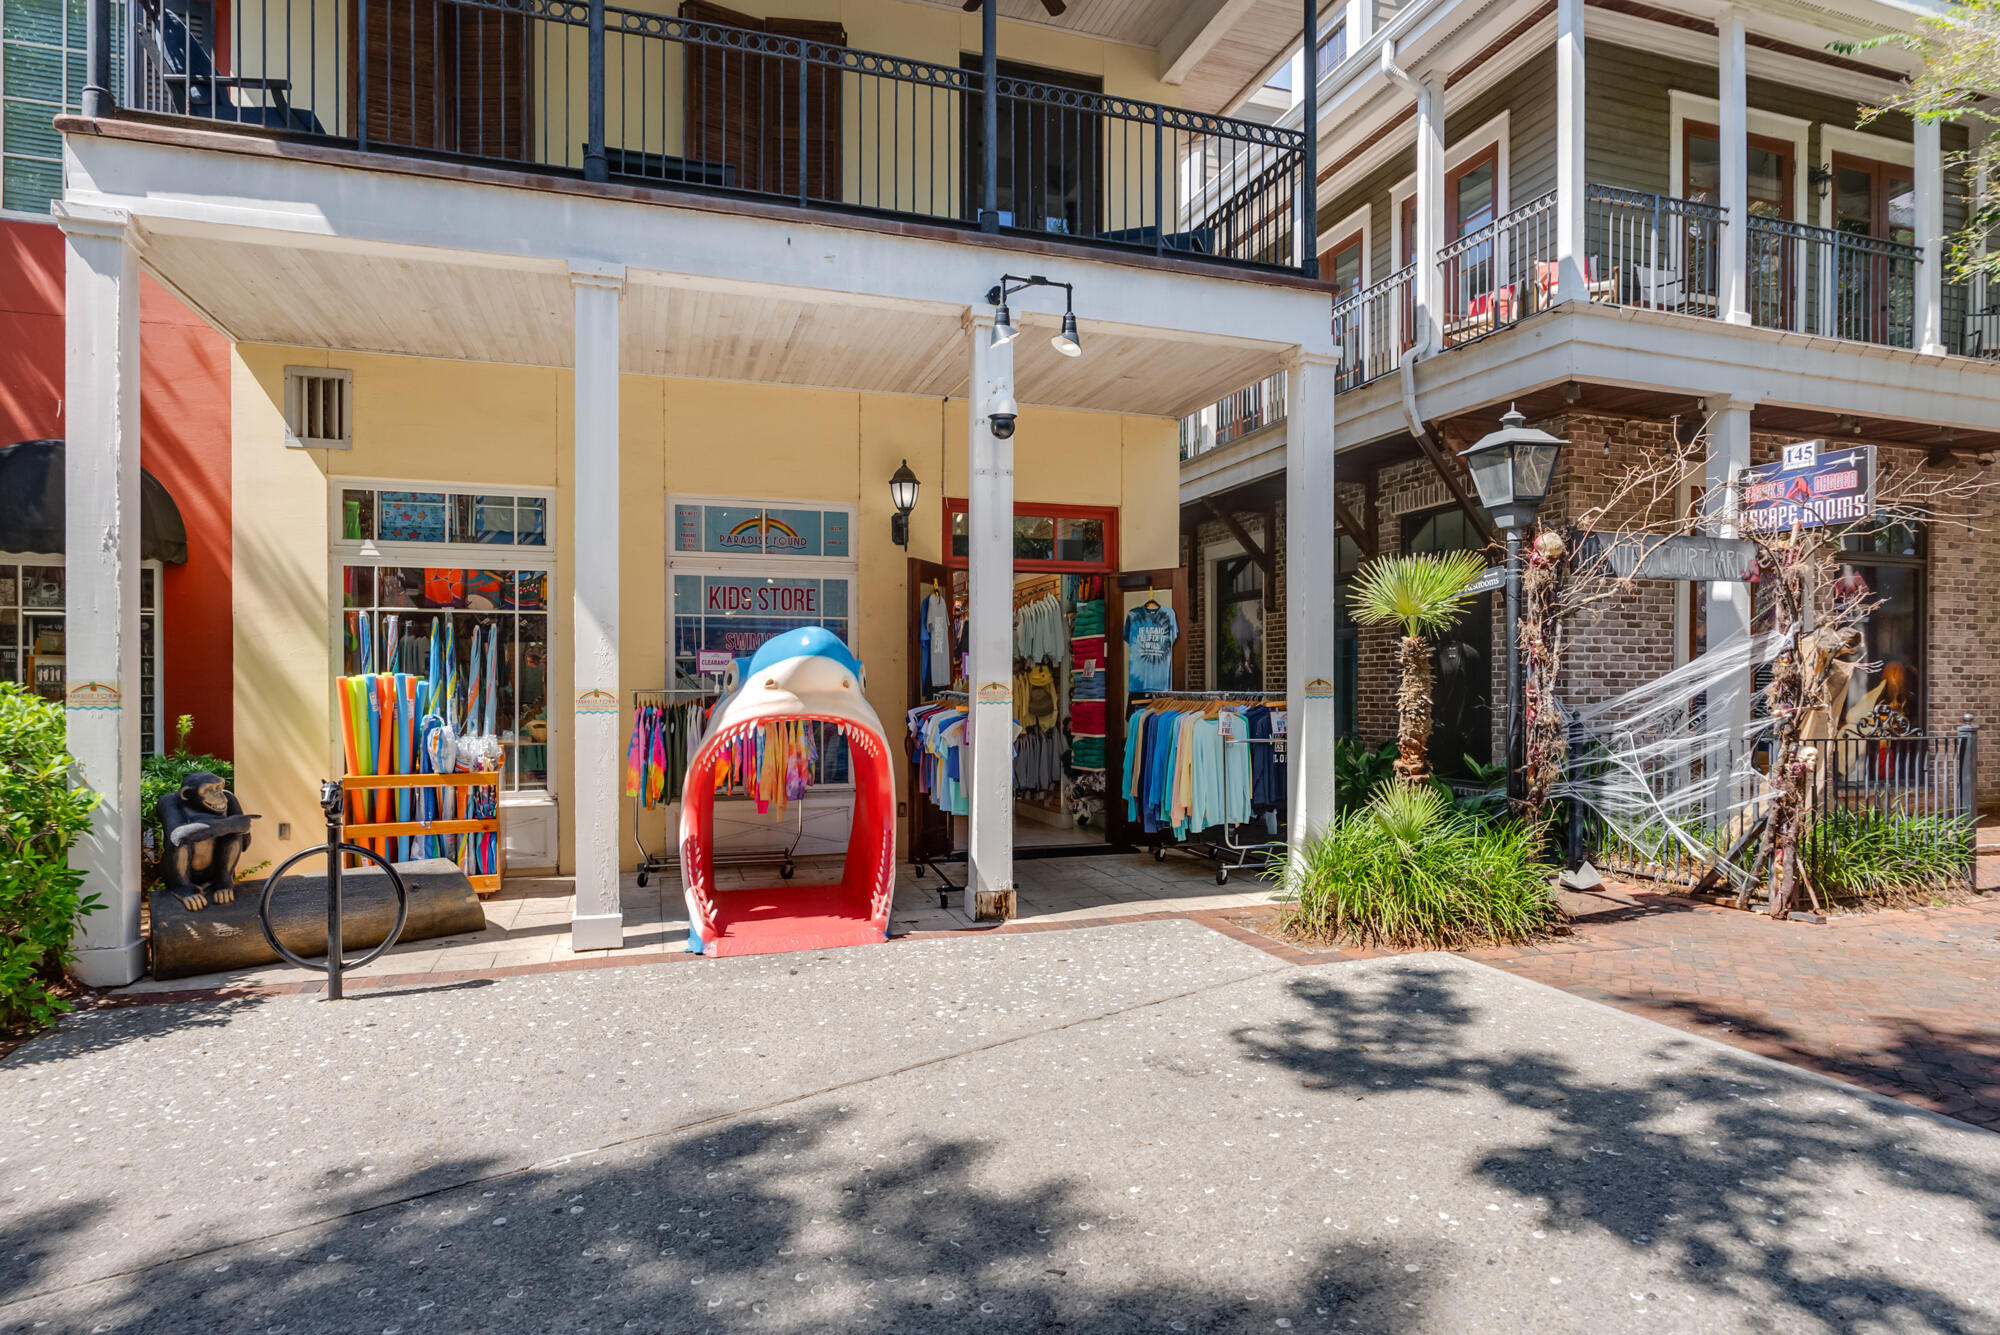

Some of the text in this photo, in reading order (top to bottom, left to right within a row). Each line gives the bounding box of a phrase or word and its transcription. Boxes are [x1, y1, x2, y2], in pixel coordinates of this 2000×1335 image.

[1786, 445, 1813, 463] 145
[1803, 495, 1865, 521] ROOMS
[720, 535, 807, 546] PARADISE FOUND
[709, 586, 816, 612] KIDS STORE
[726, 632, 779, 650] SWIM
